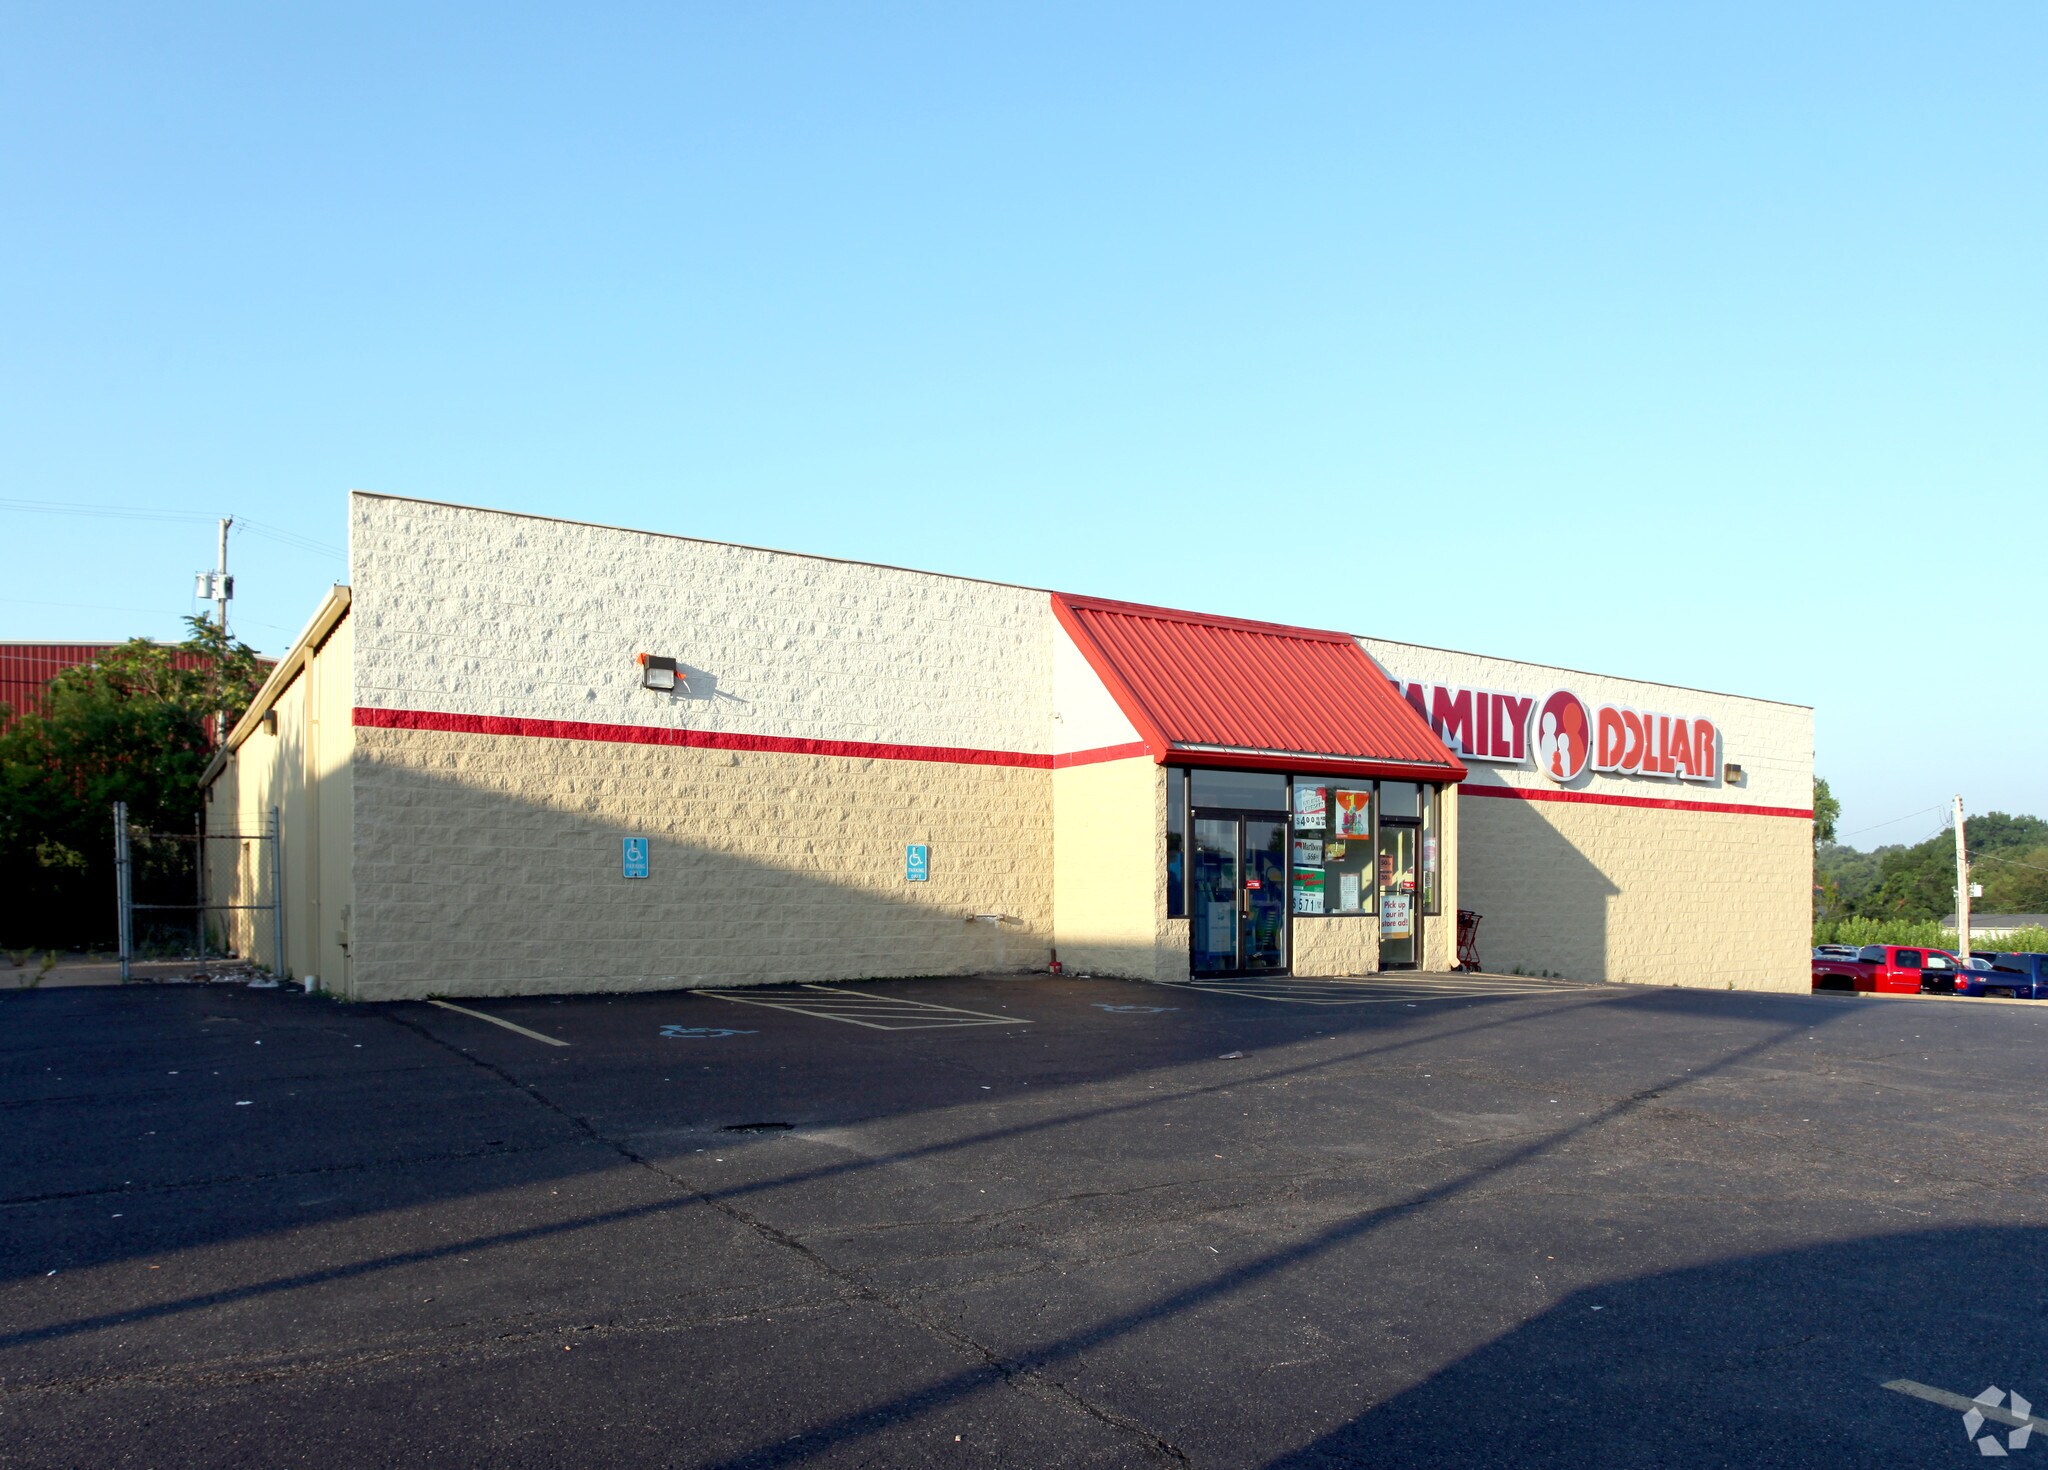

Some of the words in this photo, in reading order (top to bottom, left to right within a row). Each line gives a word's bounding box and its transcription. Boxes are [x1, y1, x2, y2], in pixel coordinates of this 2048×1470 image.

[1389, 680, 1533, 759] MILY
[1597, 706, 1715, 778] DOLLAR
[1384, 901, 1396, 909] Pick
[1398, 902, 1406, 910] up
[1398, 910, 1403, 918] in
[1397, 919, 1408, 927] ad!
